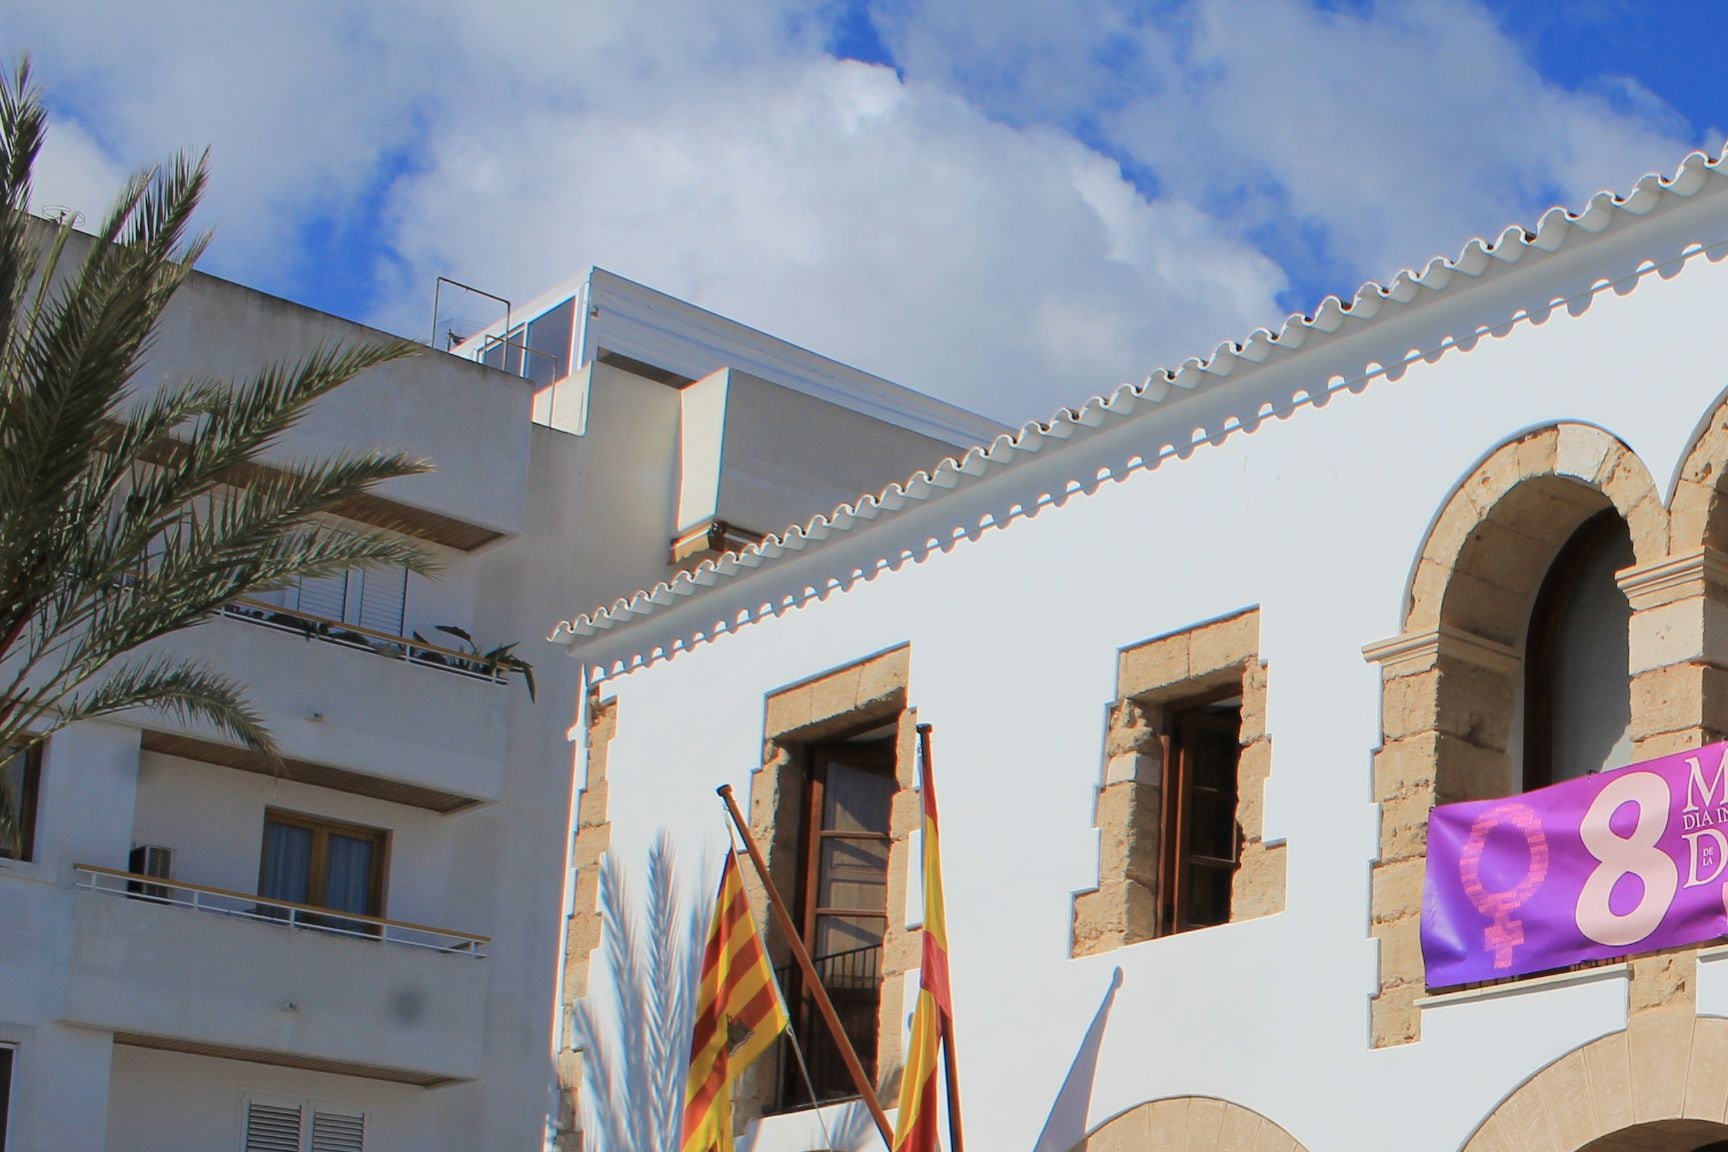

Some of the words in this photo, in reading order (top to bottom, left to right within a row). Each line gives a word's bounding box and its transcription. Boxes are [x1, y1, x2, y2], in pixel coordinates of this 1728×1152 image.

[1682, 811, 1714, 831] DIA
[1575, 770, 1679, 947] 8
[1702, 846, 1714, 857] DE
[1702, 856, 1714, 866] LA
